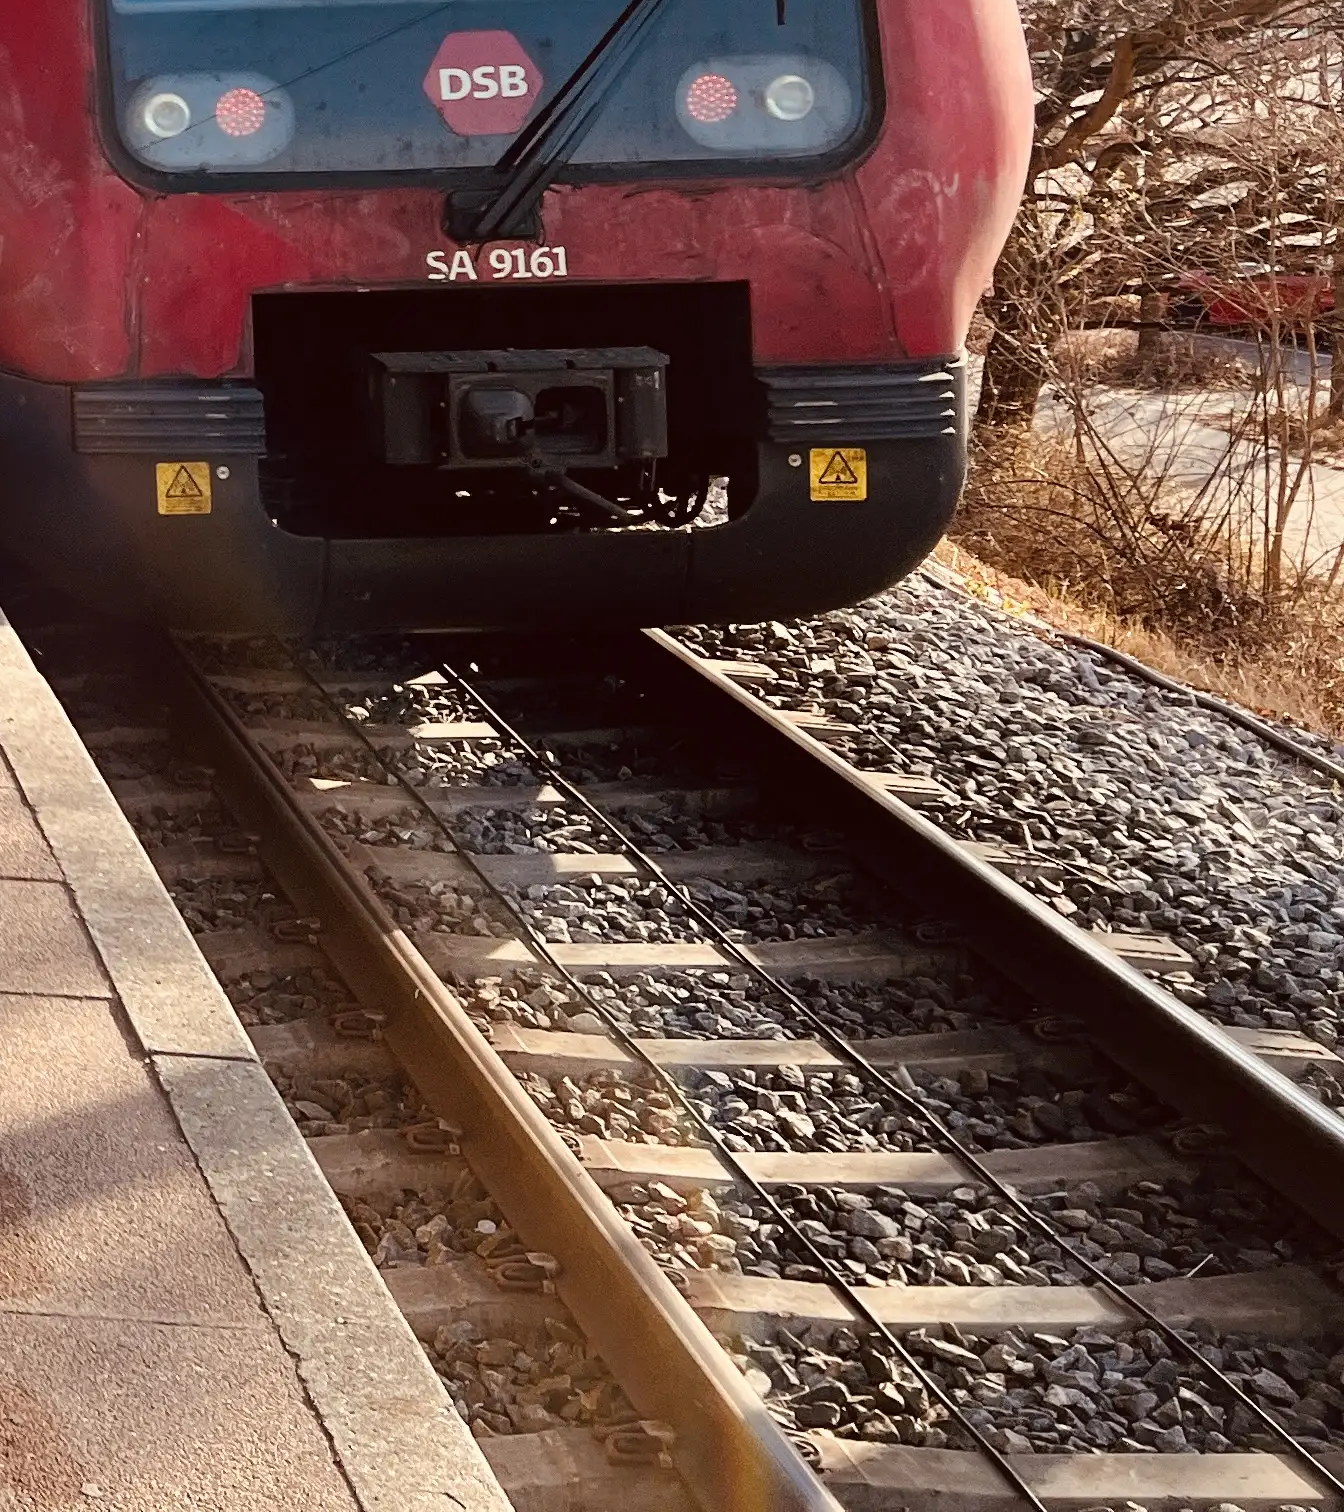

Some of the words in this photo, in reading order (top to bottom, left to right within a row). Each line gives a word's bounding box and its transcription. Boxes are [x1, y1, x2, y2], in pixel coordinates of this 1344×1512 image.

[439, 65, 528, 100] DSB
[426, 250, 478, 281] SA
[489, 246, 568, 279] 9161
